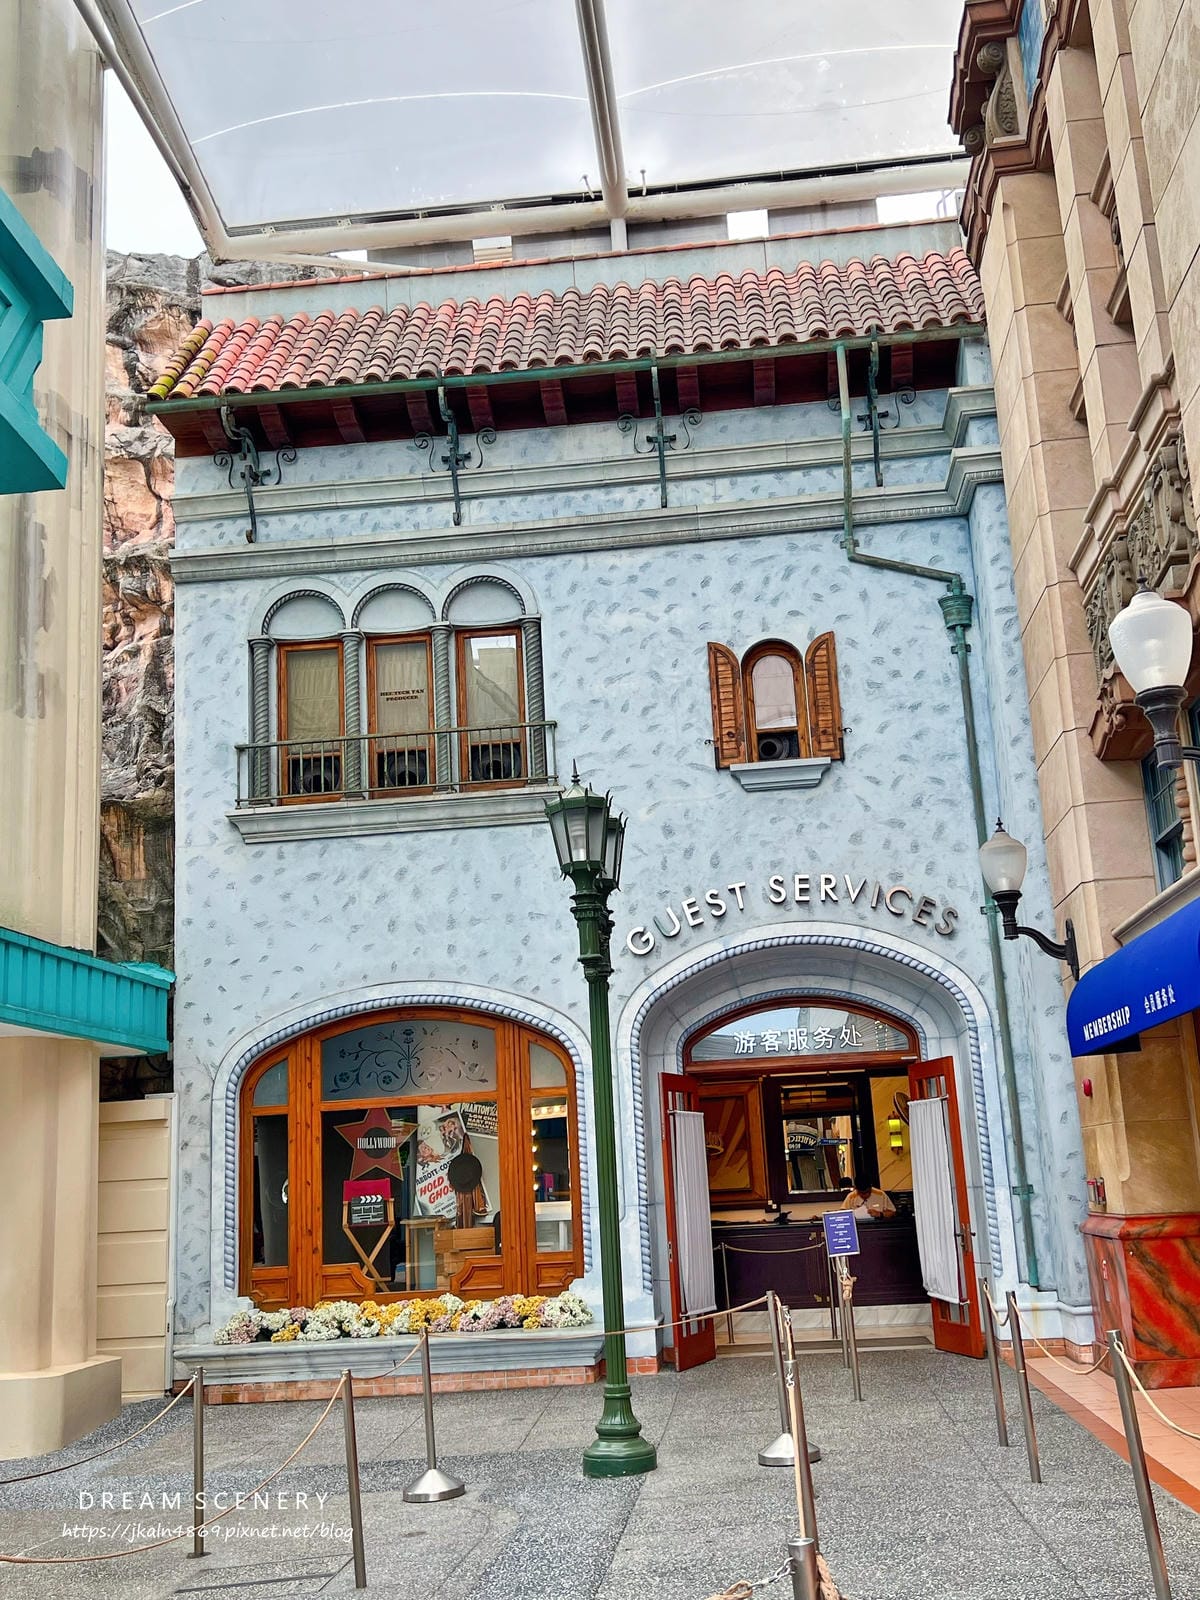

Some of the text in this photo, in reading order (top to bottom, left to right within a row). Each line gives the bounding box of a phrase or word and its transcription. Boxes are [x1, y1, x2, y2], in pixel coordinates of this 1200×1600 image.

[626, 874, 958, 956] GUEST SERVICES
[1083, 1005, 1131, 1042] MEMBERSHIP
[733, 1024, 864, 1054] 游客服务处
[461, 1103, 492, 1115] PHANTOM
[357, 1137, 396, 1149] HOLLYWOOD
[419, 1176, 445, 1197] HOLD
